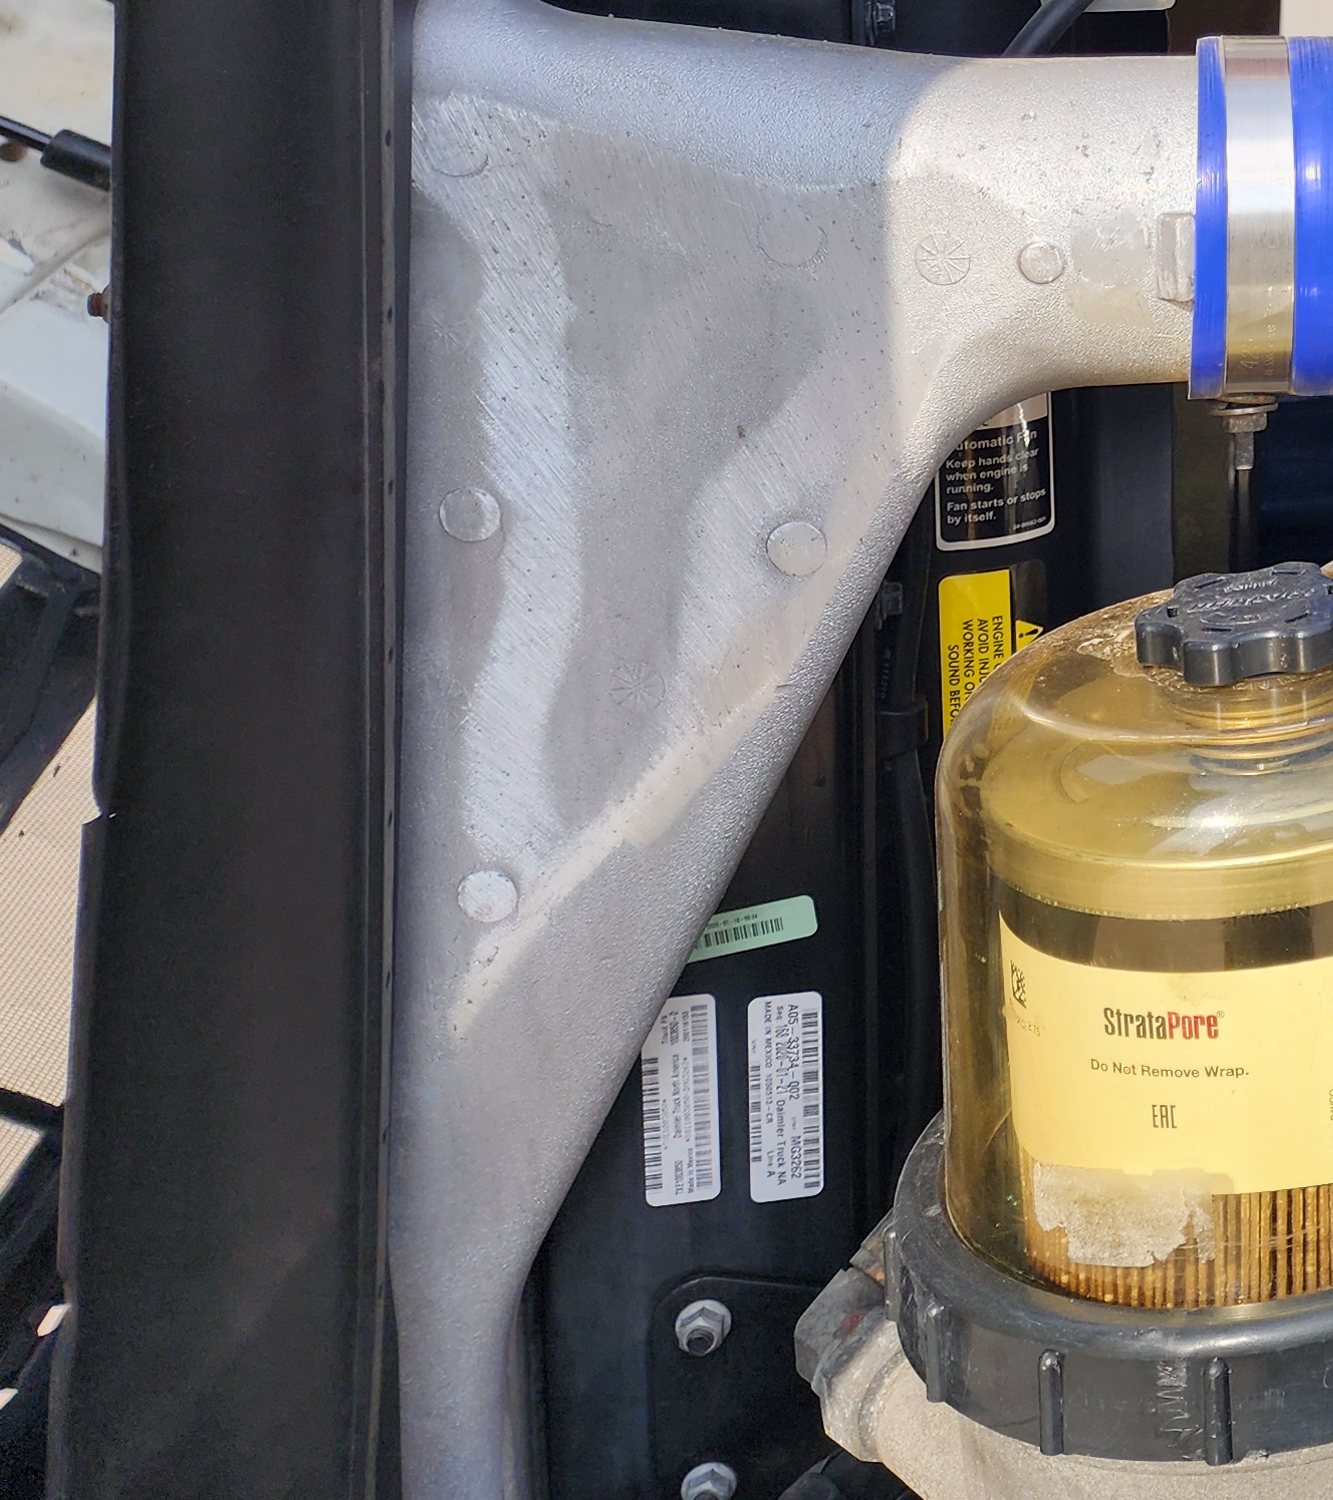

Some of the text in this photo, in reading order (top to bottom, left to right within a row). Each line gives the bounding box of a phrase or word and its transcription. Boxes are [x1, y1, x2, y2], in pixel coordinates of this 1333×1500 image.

[956, 434, 1014, 450] utomatic
[946, 448, 1039, 469] Keep hands clear
[946, 463, 1028, 481] when engine is
[946, 482, 994, 495] running.
[947, 487, 1046, 511] Fan starts or stops
[947, 511, 997, 526] by itself.
[977, 618, 989, 655] AVOID
[992, 615, 1004, 659] ENGINE
[962, 618, 976, 678] WORKING
[948, 644, 960, 687] SOUND
[764, 1027, 771, 1036] IN
[1090, 1058, 1250, 1079] Do Not Remove Wrap.
[776, 1099, 785, 1138] Daimler
[777, 1141, 785, 1168] Truck
[790, 1135, 801, 1179] MG3262
[777, 1171, 786, 1186] NA
